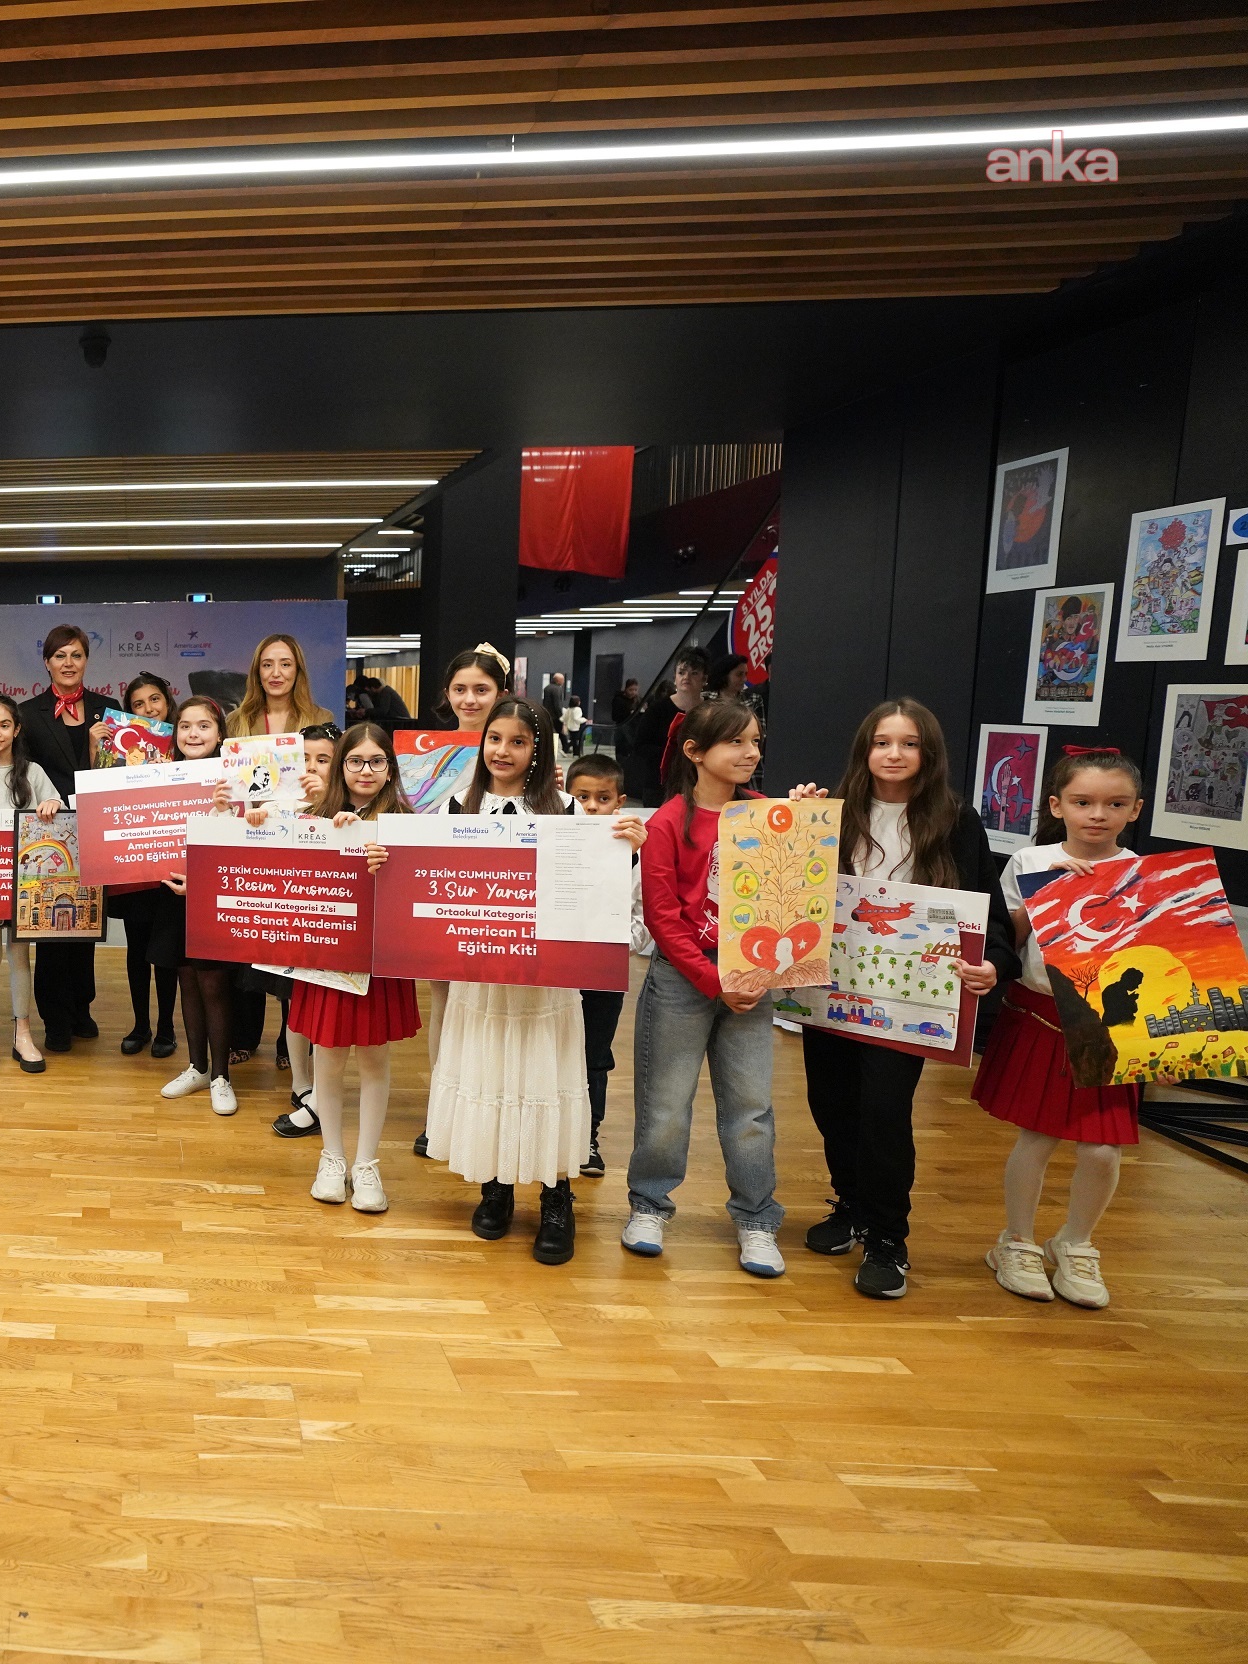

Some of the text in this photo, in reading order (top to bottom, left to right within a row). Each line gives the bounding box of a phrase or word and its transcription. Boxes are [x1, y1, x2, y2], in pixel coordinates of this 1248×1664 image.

[741, 569, 774, 616] 5 YILDA
[118, 642, 160, 652] KREAS
[750, 624, 775, 668] PRO
[113, 804, 130, 812] EKİM
[132, 800, 182, 811] CUMHURİYET
[183, 798, 214, 806] BAYRAM
[113, 814, 123, 824] 3.
[120, 827, 186, 838] Ortaokul Kategoris
[127, 838, 186, 851] American Li
[344, 846, 368, 854] Hediy
[114, 852, 178, 864] %100 Eğitim
[218, 864, 358, 880] 29 EKİM CUMHURİYET BAYRAMI
[414, 868, 532, 880] 29 EKİM CUMHURİYET
[220, 876, 354, 898] 3. Resim Yarışması
[428, 880, 442, 896] 3.
[445, 881, 478, 900] Şiir
[236, 900, 273, 910] Ortaokul
[274, 902, 318, 912] Kategorisi
[436, 908, 536, 920] Ortaokul Kategorisi
[217, 912, 357, 932] Kreas Sanat Akademisi
[957, 921, 981, 931] Çeki
[230, 928, 339, 945] %50 Eğitim Bursu
[446, 924, 516, 938] American
[458, 942, 537, 956] Eğitim Kiti
